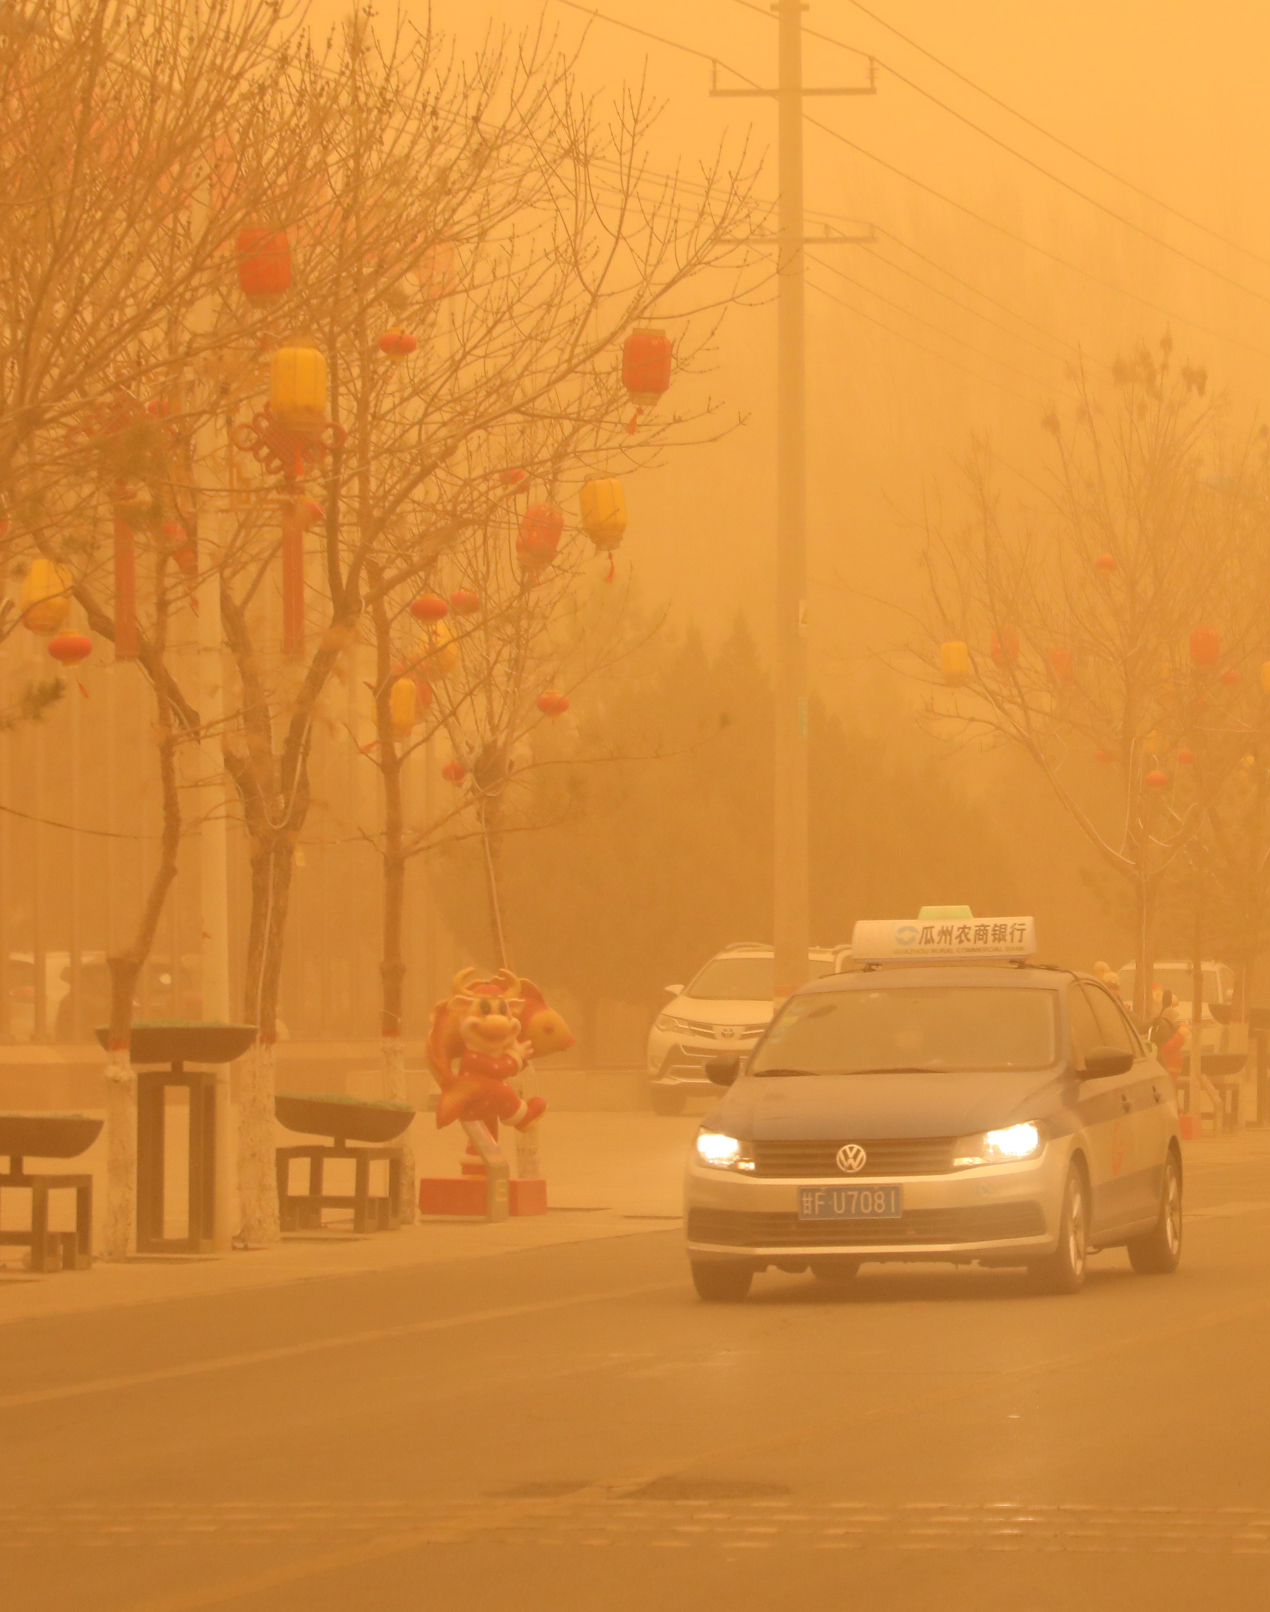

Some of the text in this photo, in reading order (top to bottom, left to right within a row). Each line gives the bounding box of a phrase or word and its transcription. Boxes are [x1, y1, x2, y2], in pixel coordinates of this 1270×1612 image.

[918, 923, 1026, 945] 瓜州农商银行
